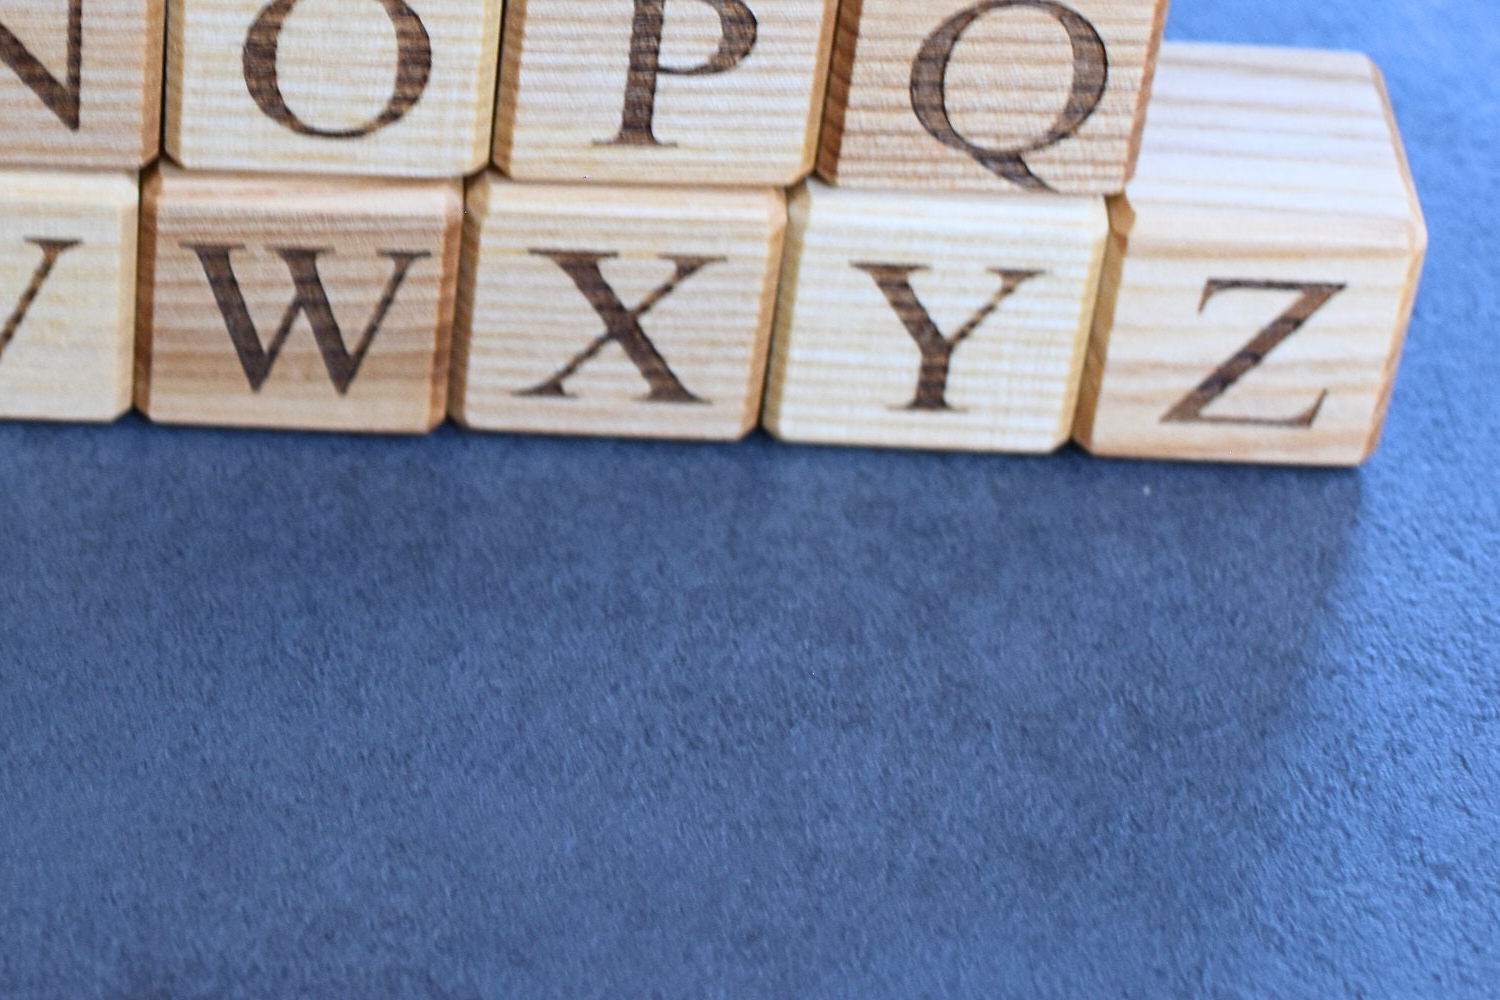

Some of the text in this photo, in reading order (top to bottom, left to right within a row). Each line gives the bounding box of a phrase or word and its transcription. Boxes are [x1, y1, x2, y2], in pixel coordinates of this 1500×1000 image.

[179, 242, 431, 395] W
[511, 249, 726, 404] X
[852, 262, 1044, 413] Y
[1160, 278, 1347, 429] Z
